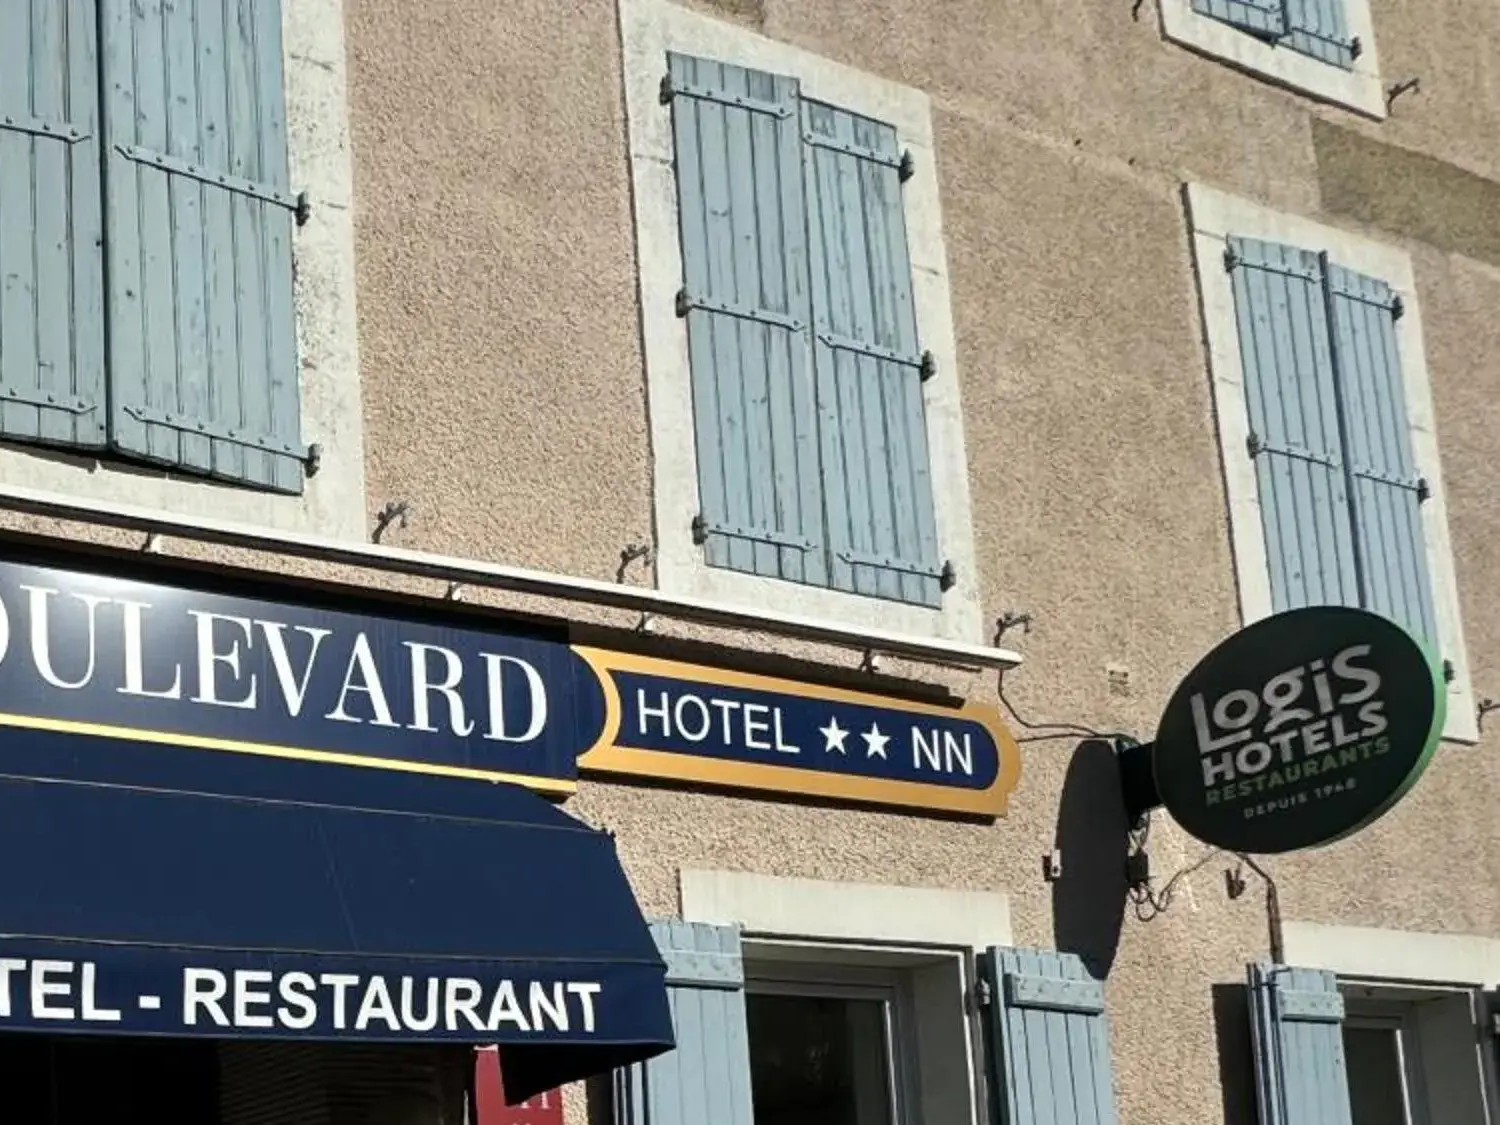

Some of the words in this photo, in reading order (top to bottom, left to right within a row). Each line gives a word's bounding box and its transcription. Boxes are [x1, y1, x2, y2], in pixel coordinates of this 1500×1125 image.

[637, 688, 801, 754] HOTEL
[911, 725, 974, 776] NN
[1201, 701, 1388, 787] HOTELS
[1205, 736, 1391, 806] RESTAURANTS
[183, 967, 602, 1033] RESTAURANT
